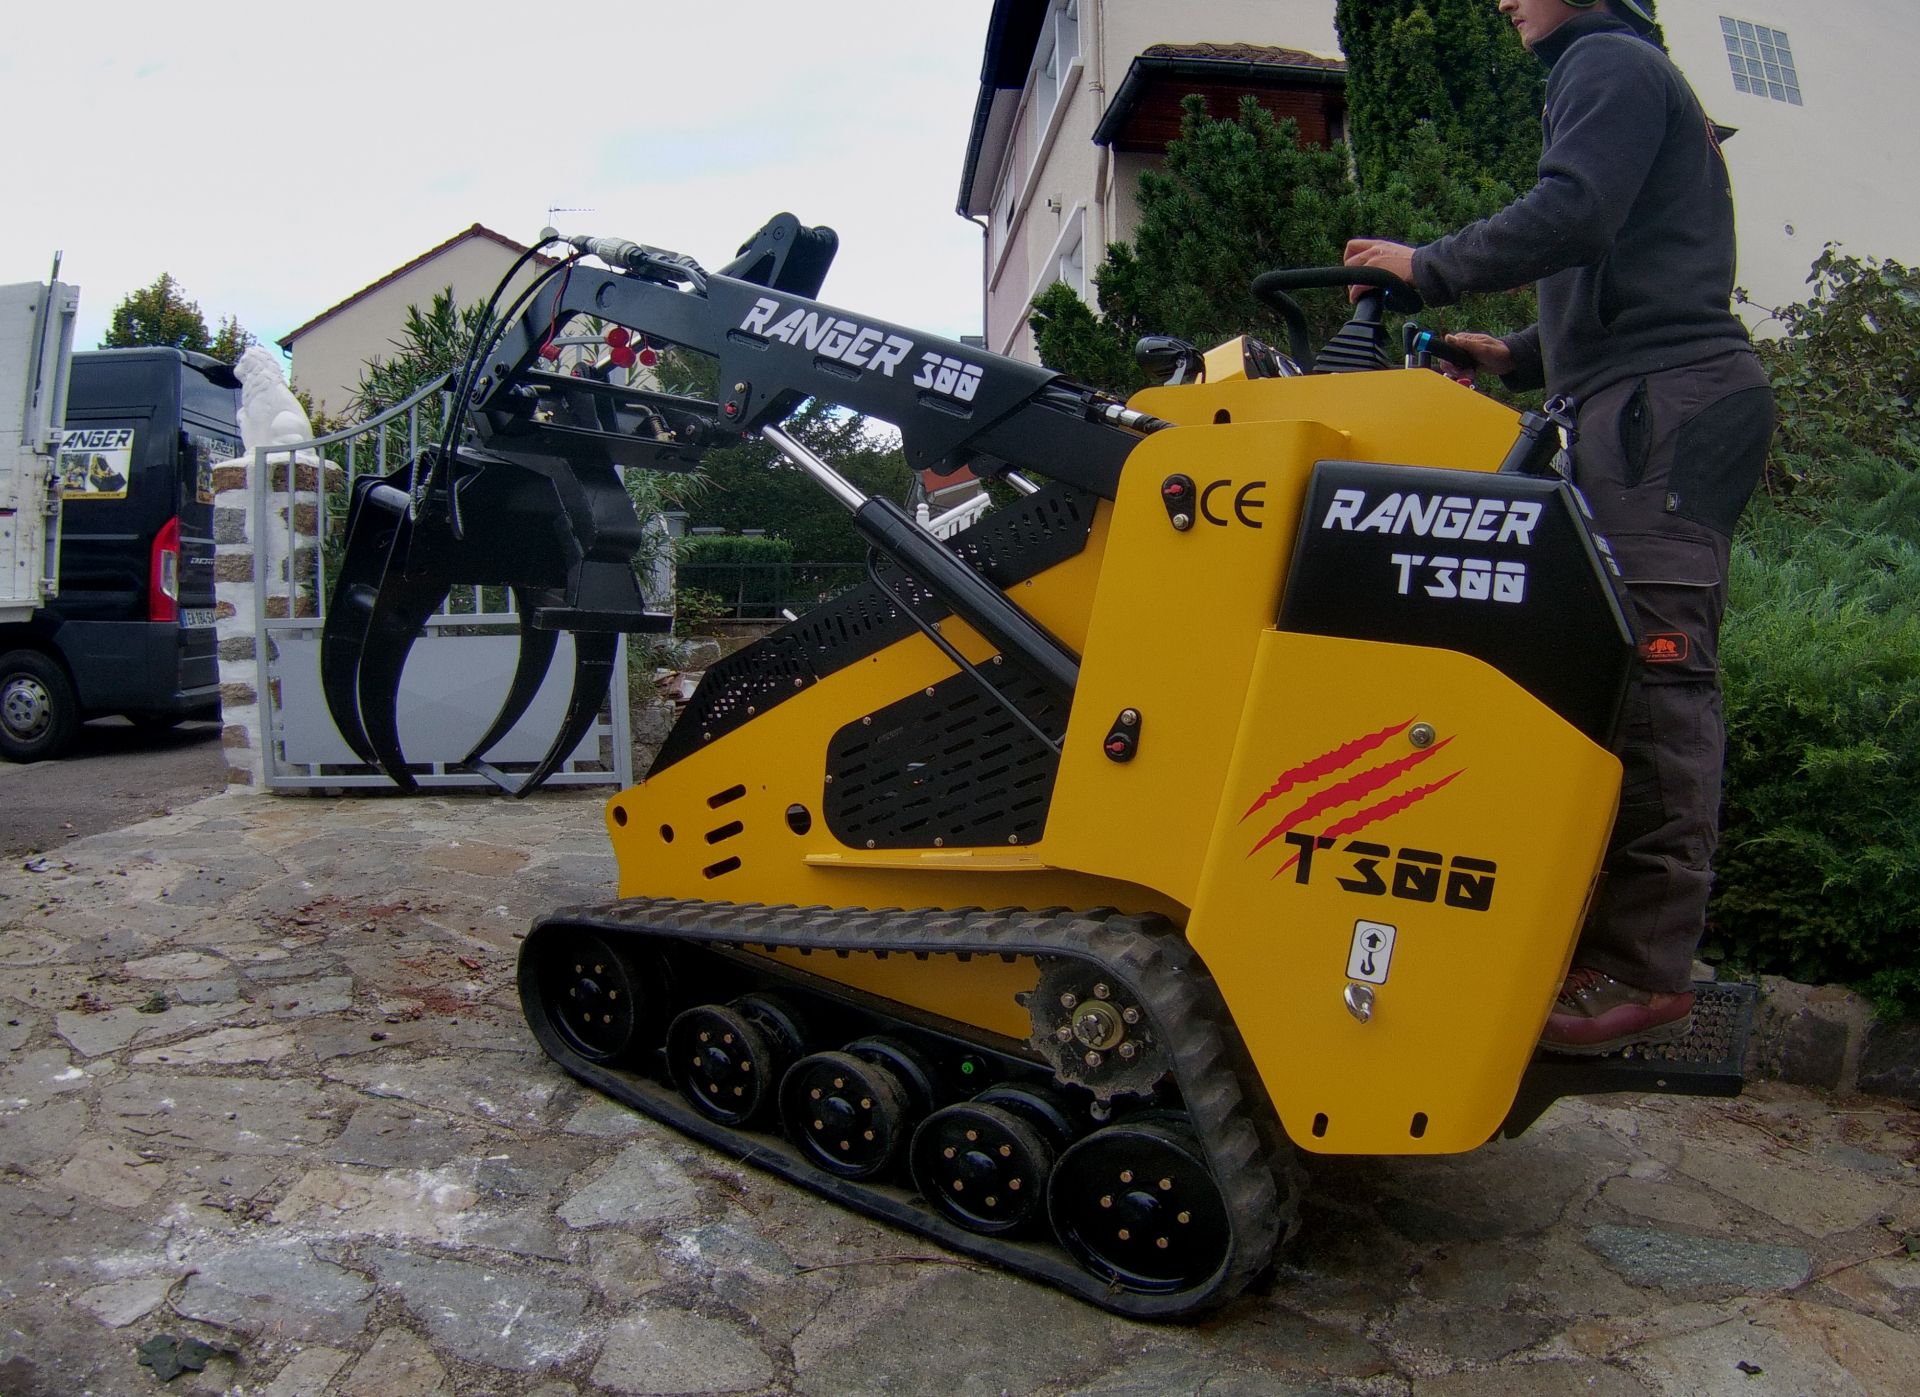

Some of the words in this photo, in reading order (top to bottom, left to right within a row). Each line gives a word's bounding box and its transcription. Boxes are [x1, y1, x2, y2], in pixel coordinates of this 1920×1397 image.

[740, 298, 914, 377] RANGER
[913, 352, 984, 402] 300
[62, 430, 132, 448] ANGER
[1200, 479, 1267, 529] CE
[1322, 489, 1543, 545] RANGER
[1391, 553, 1526, 604] T300
[1285, 832, 1497, 912] T300
